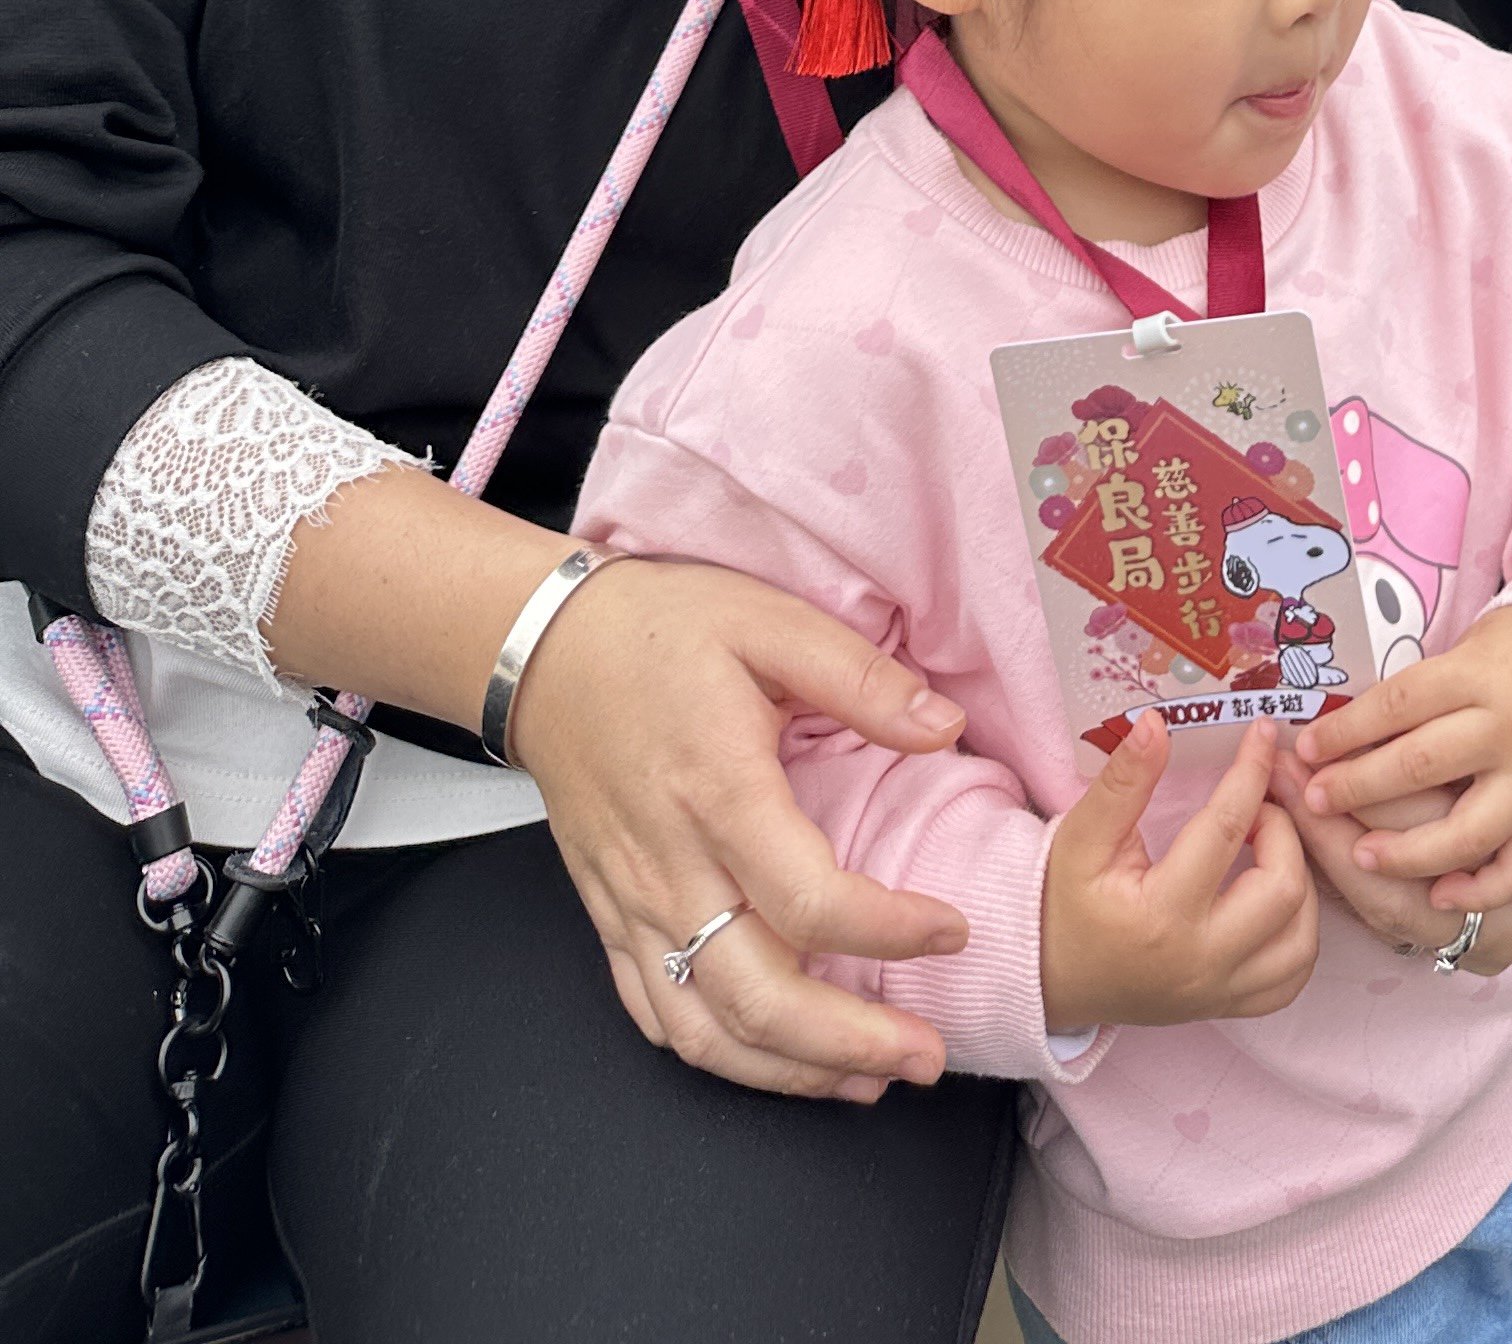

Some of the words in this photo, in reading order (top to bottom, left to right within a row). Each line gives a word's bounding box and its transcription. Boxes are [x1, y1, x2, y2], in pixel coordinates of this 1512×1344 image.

[1077, 418, 1166, 594] 保良局
[1151, 457, 1223, 640] 慈善步行
